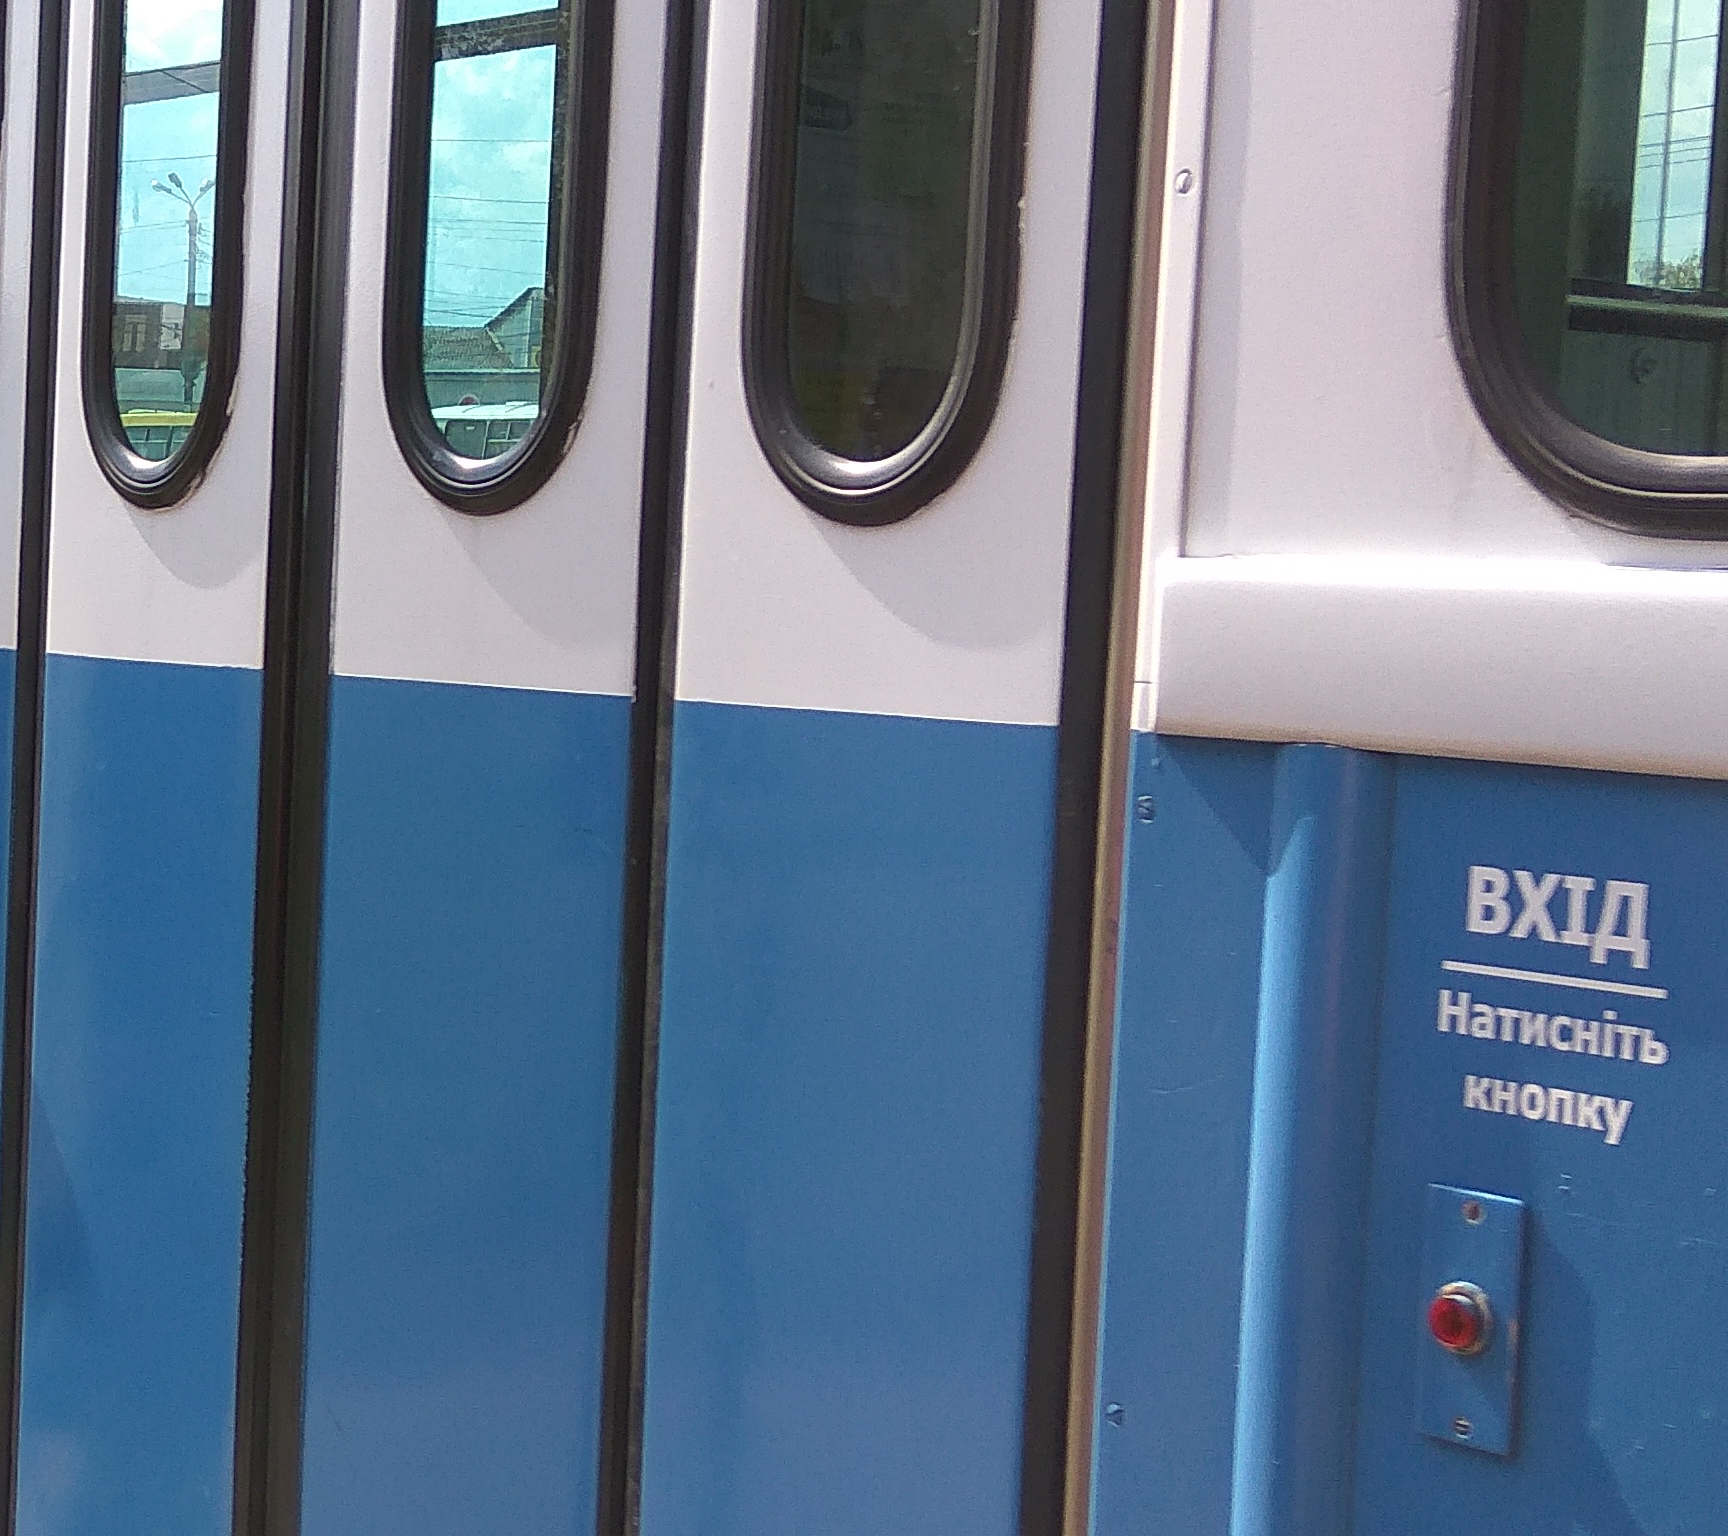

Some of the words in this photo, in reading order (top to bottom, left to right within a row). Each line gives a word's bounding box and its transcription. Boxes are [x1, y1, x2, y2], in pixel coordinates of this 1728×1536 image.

[1465, 865, 1650, 969] ВХІД
[1437, 989, 1669, 1066] Натисніть
[1464, 1075, 1633, 1145] кнопку
